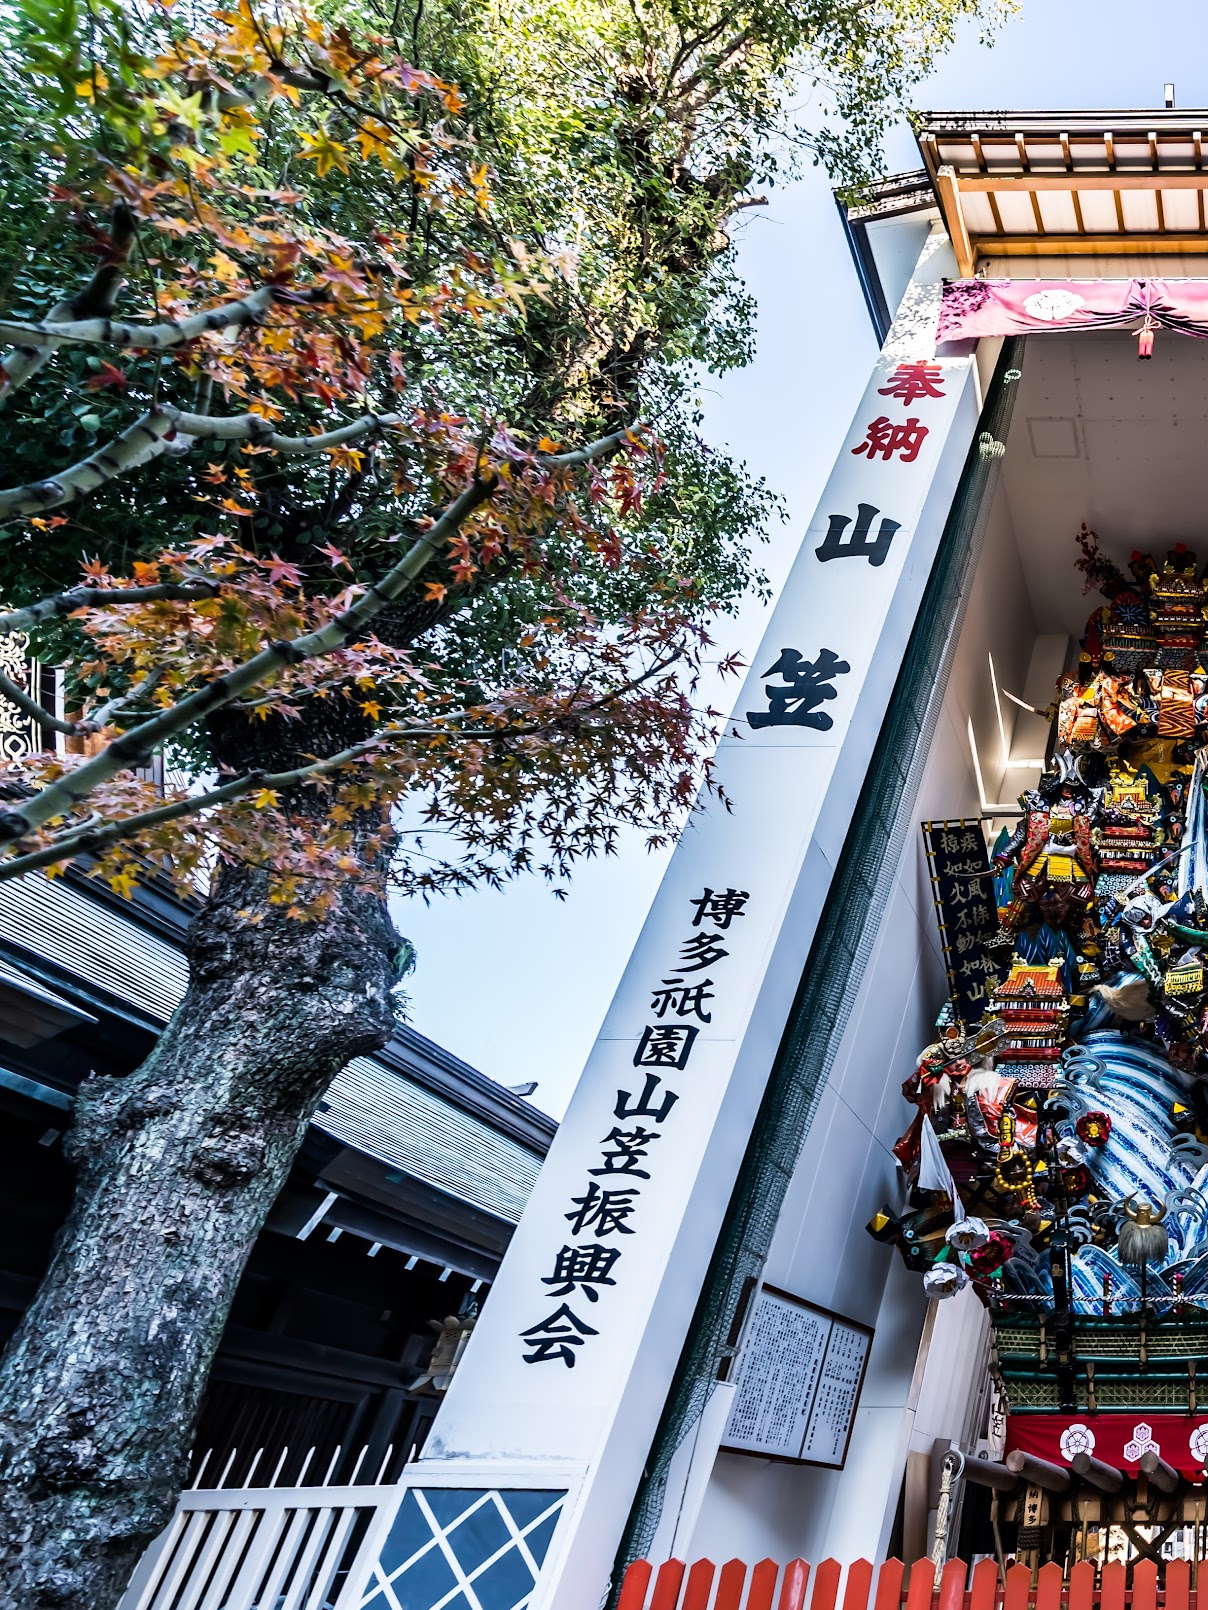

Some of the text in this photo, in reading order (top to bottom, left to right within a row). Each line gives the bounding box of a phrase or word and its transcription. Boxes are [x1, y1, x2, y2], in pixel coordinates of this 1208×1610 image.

[852, 359, 947, 463] 奉納
[746, 502, 902, 732] 山笠
[519, 887, 751, 1369] 博多祇園山笠振興会
